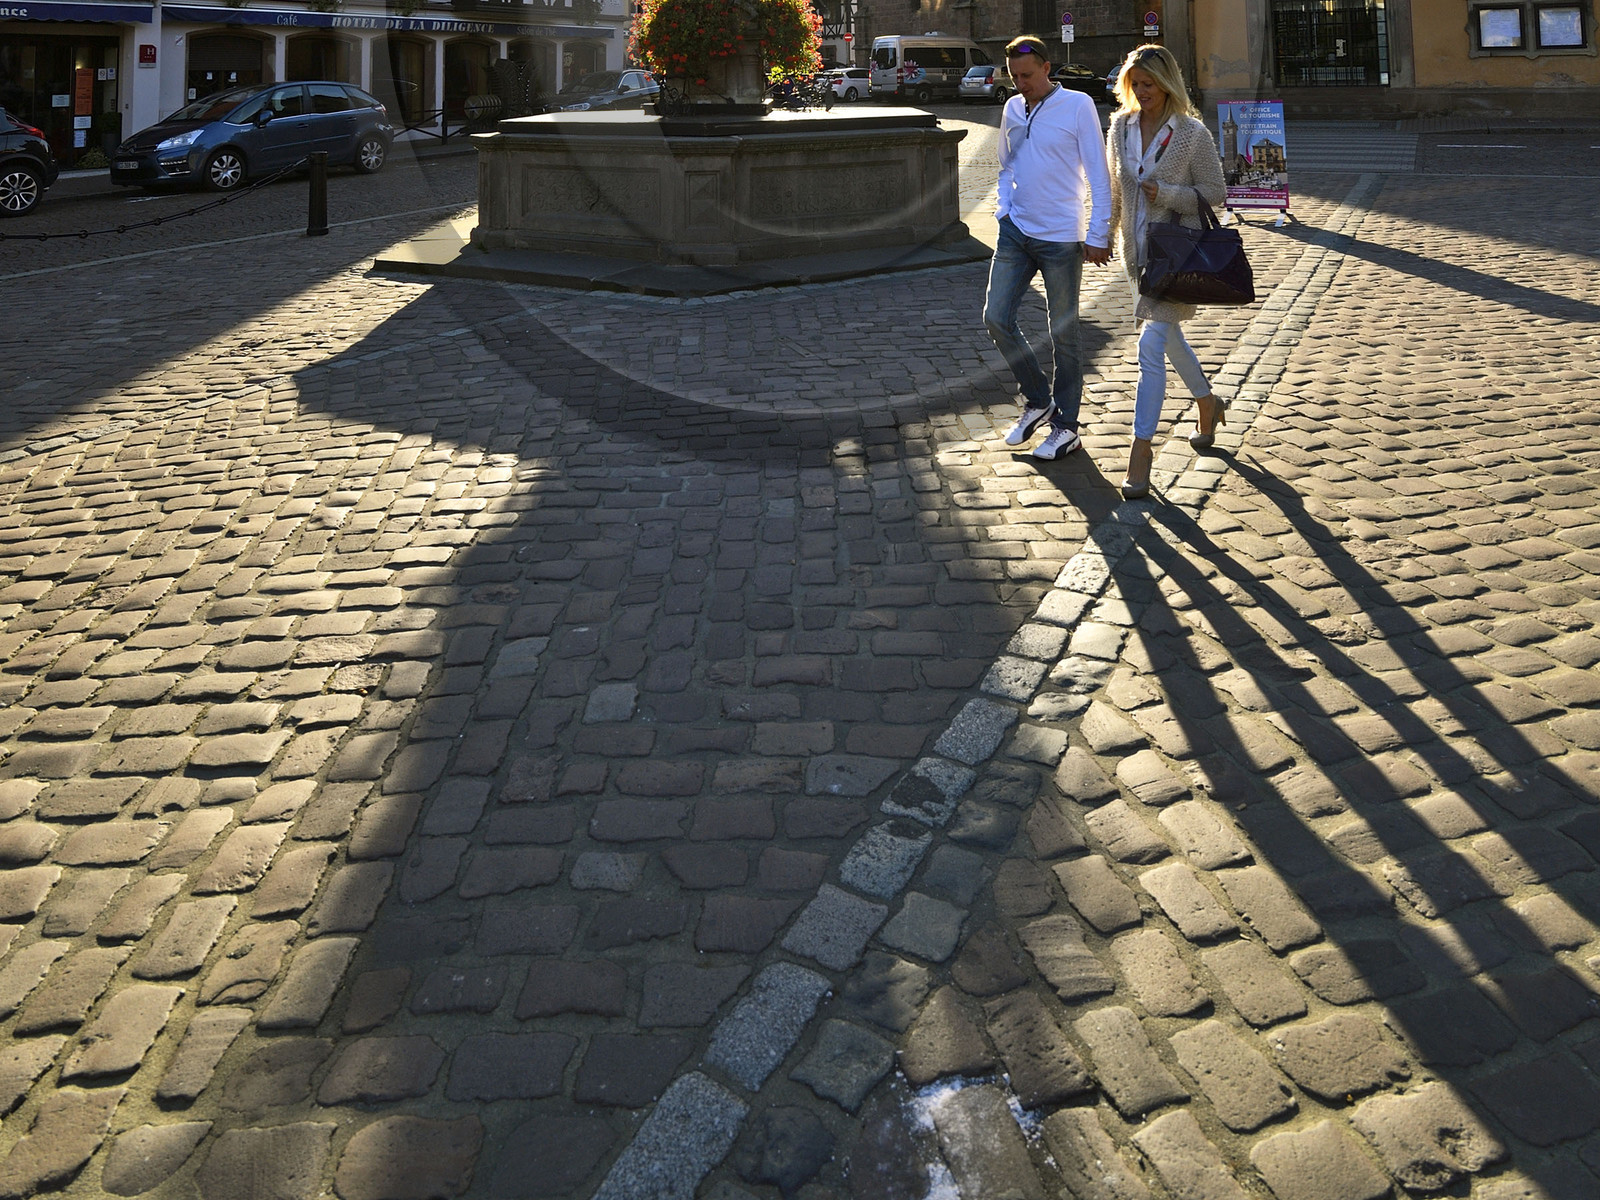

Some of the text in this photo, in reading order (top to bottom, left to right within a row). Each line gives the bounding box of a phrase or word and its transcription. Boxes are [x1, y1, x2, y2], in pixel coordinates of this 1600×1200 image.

[276, 14, 298, 26] Café
[385, 19, 403, 30] DE
[409, 20, 425, 31] LA
[432, 21, 495, 33] DILIGENCE
[147, 47, 155, 55] H
